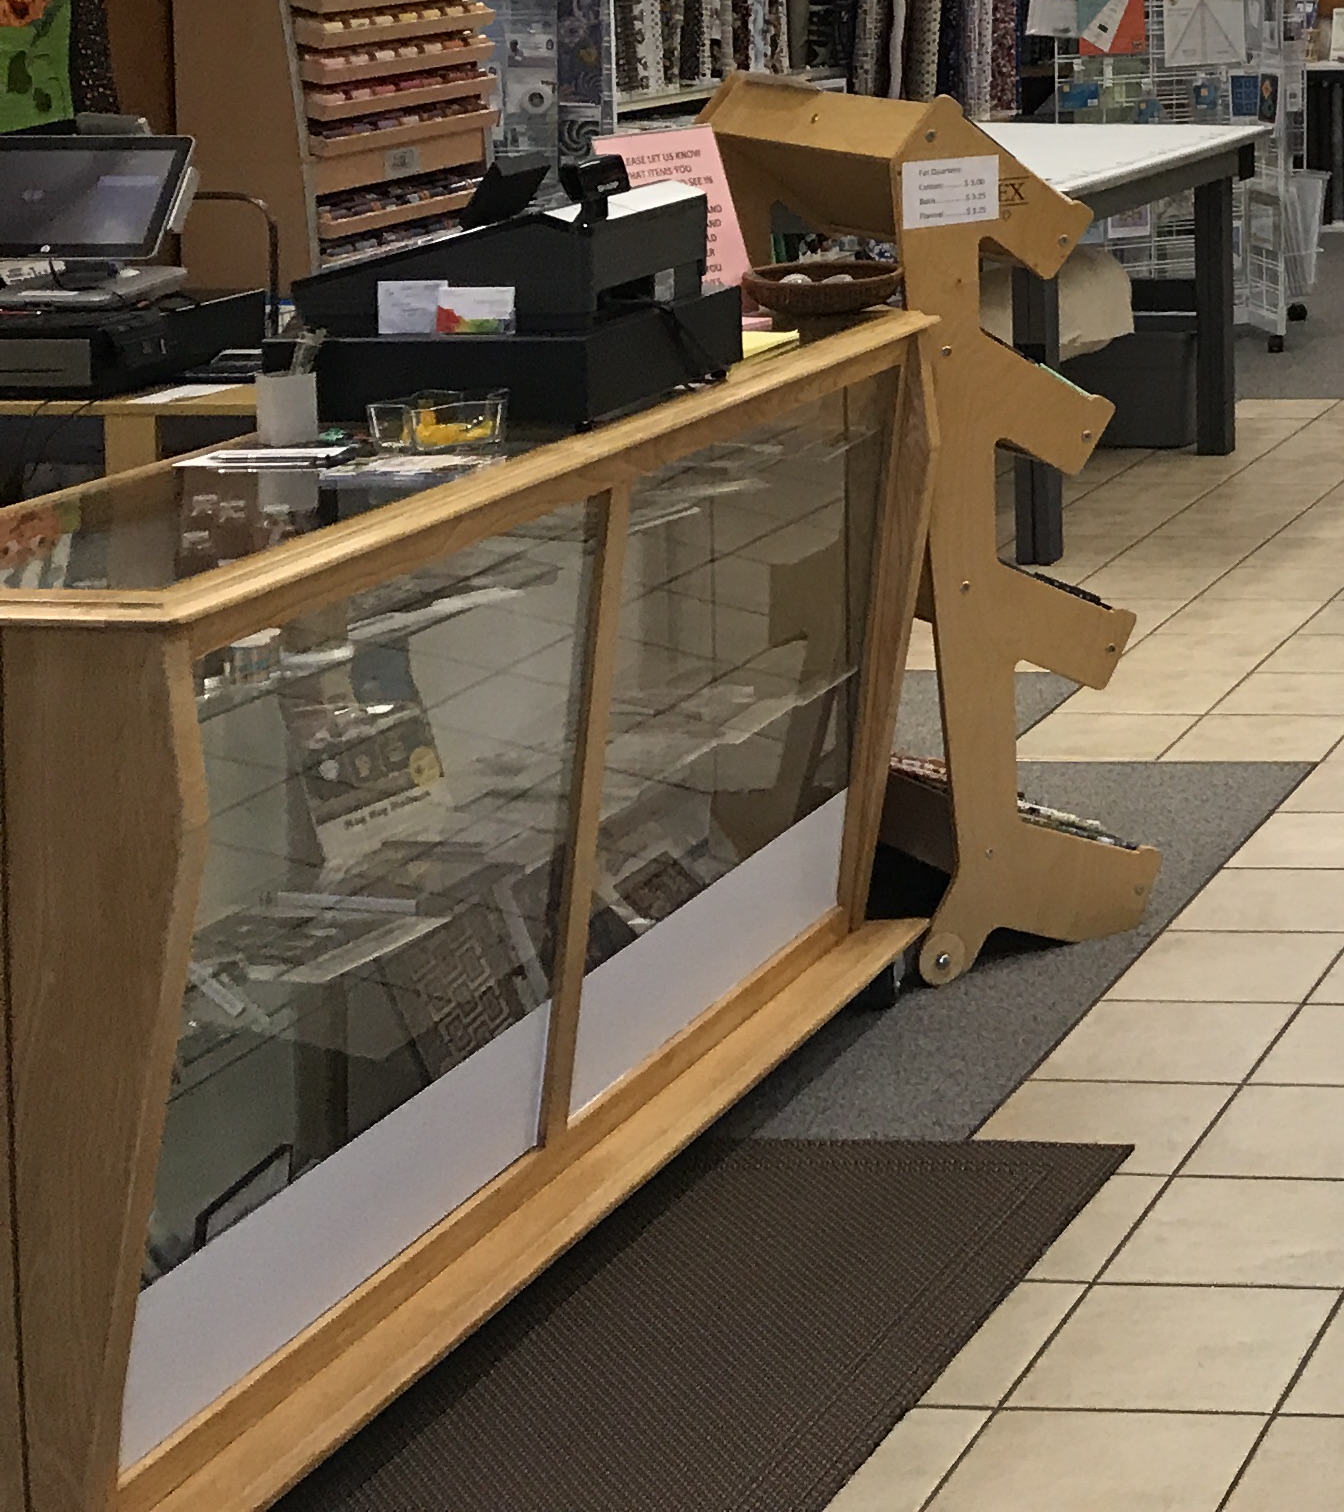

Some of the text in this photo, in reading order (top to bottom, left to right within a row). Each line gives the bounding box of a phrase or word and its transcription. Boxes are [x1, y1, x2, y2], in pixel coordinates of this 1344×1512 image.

[626, 156, 646, 166] EASE
[675, 149, 701, 160] KNOW
[629, 170, 646, 179] HAT
[674, 165, 692, 174] YOU
